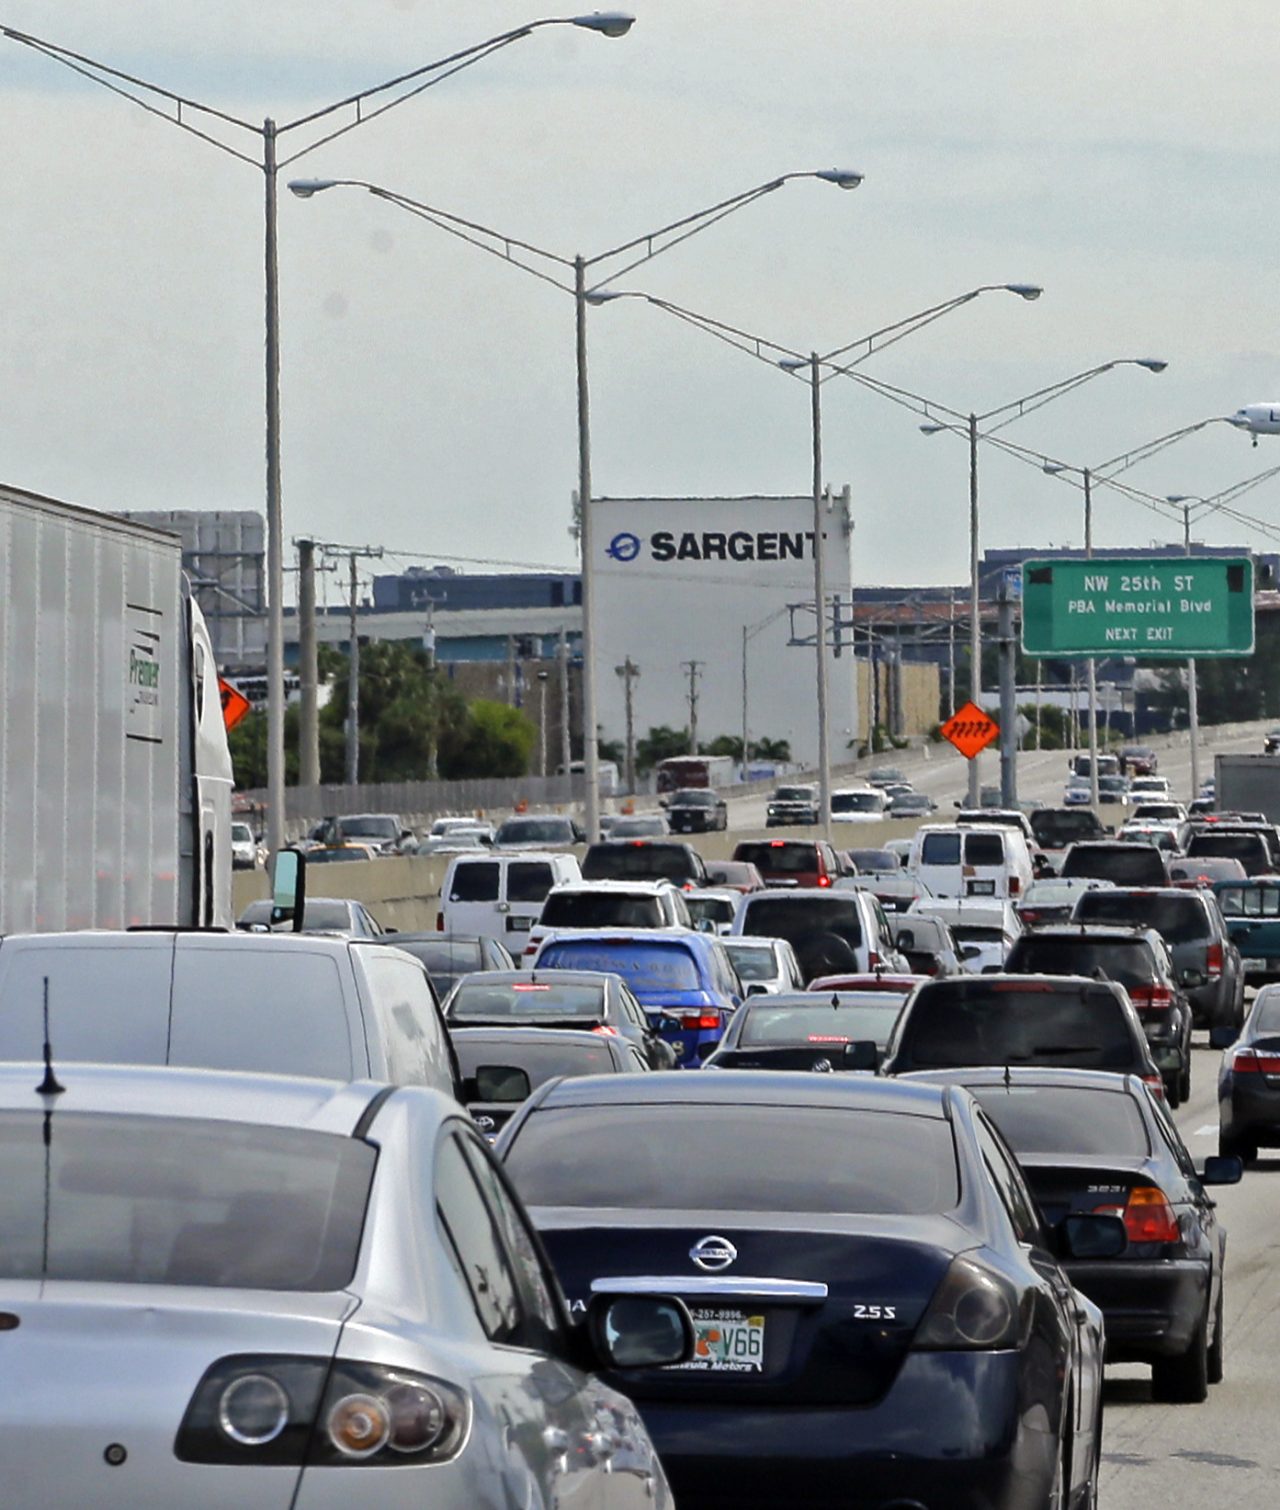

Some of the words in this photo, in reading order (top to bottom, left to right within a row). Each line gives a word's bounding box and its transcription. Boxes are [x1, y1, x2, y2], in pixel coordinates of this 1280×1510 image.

[651, 531, 827, 562] SARGENT
[1084, 575, 1109, 592] NW
[1120, 575, 1162, 592] 25th
[1174, 575, 1194, 591] ST
[1068, 601, 1096, 614] PBA
[1105, 600, 1171, 613] Memorial
[1180, 600, 1212, 613] Blvd
[1105, 628, 1137, 641] NEXT
[1147, 627, 1174, 641] EXIT
[723, 1328, 760, 1356] V66
